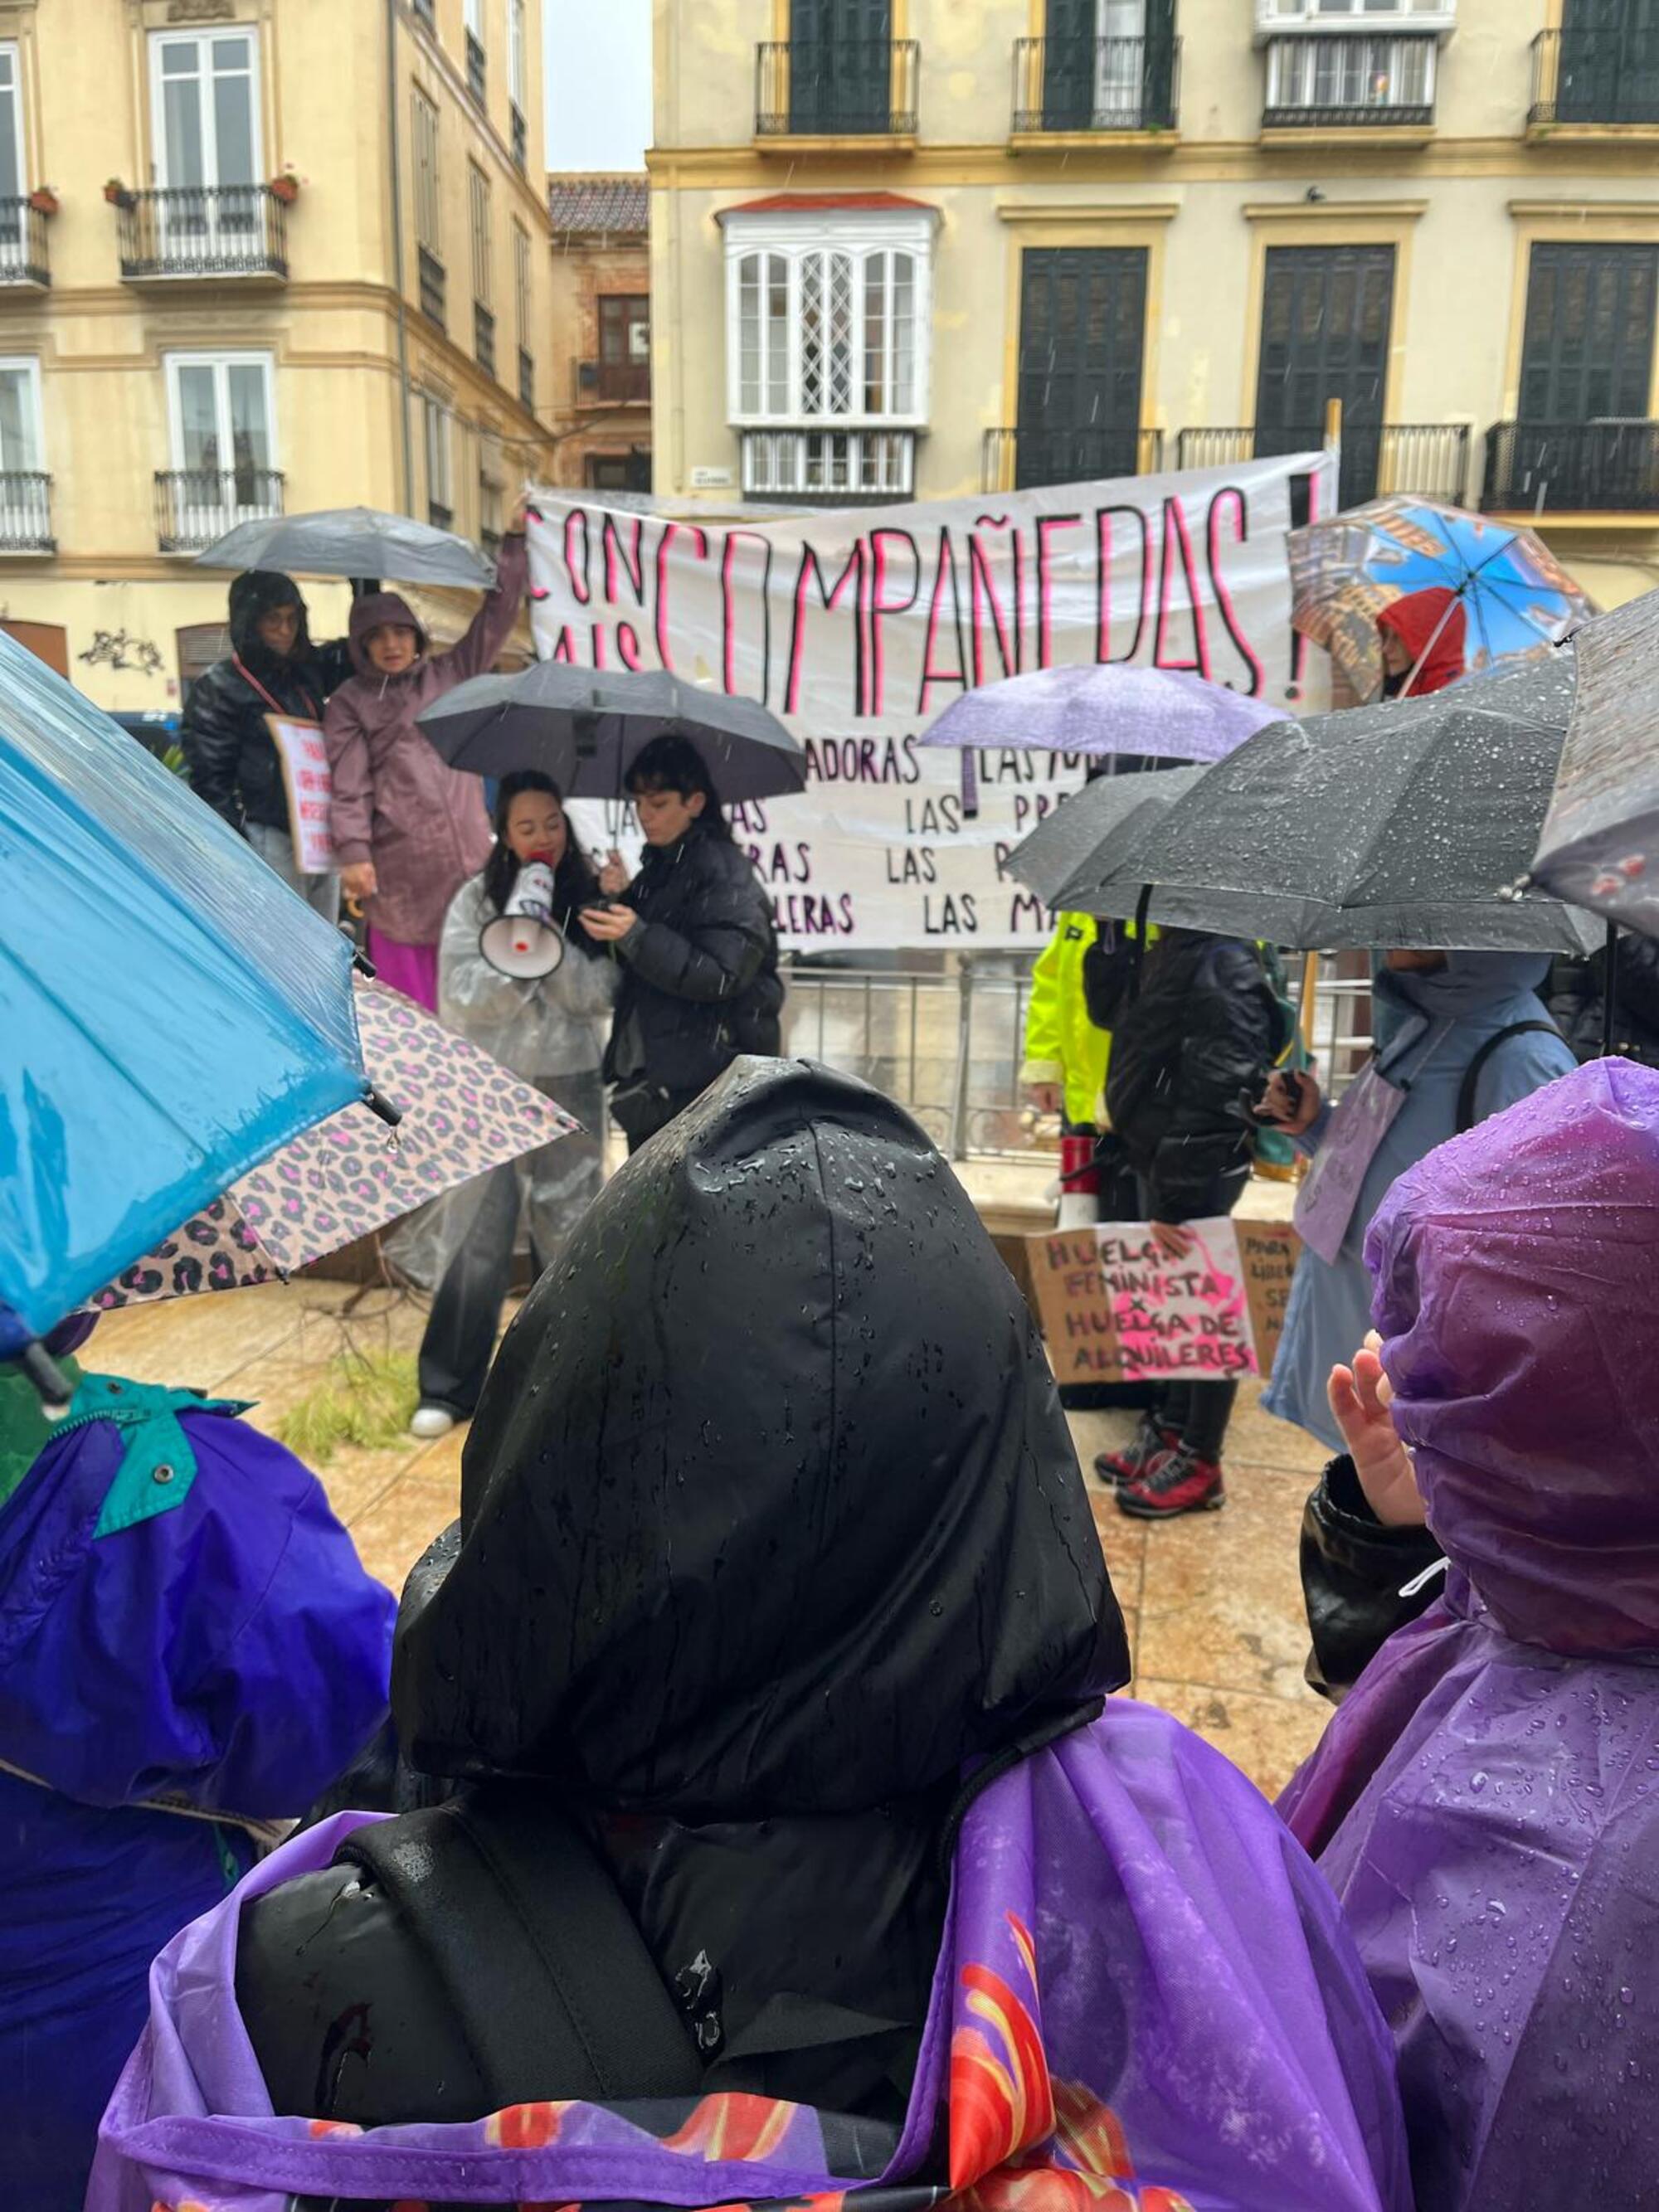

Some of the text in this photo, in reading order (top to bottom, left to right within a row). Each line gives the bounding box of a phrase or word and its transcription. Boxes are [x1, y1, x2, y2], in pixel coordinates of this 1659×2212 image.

[979, 747, 1035, 783] LAS
[905, 795, 961, 834] LAS
[886, 846, 937, 884] LAS
[924, 892, 978, 934] LAS
[1065, 1310, 1193, 1340] HUELGA
[1199, 1311, 1239, 1336] DE
